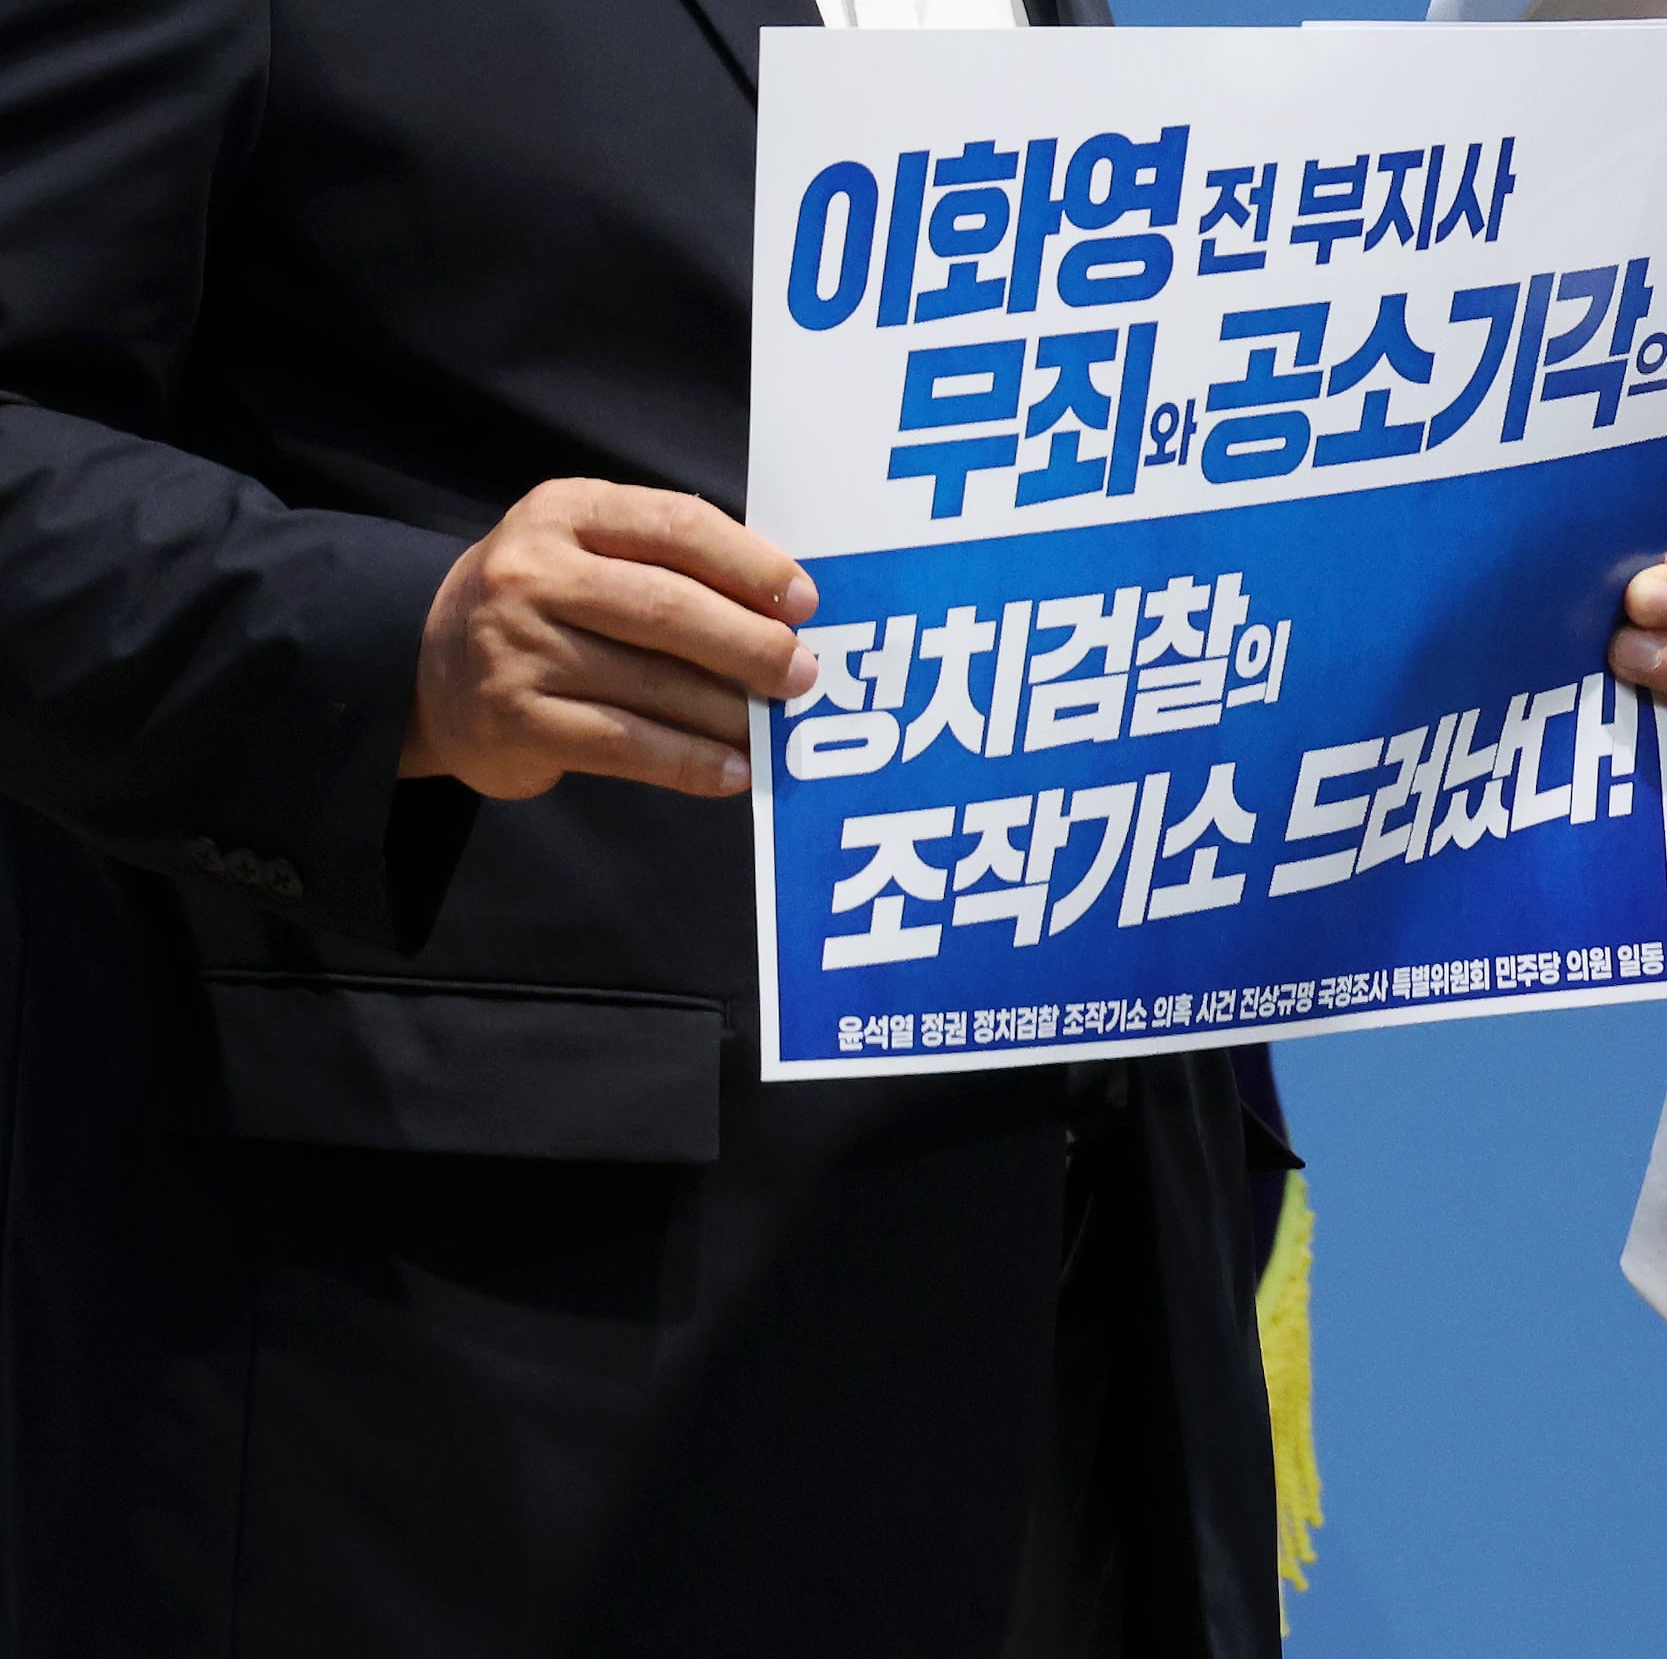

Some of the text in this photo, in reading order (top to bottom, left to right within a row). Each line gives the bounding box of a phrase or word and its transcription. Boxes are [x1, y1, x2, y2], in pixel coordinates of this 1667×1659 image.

[786, 124, 1516, 331] 이화영 전 부지사
[886, 321, 1198, 521] 무죄와
[784, 571, 1291, 781] 정치검찰의
[820, 672, 1638, 970] 조작기소 드러났다!
[838, 942, 1664, 1051] 윤석열 정권 정치검찰 조작기소 의혹 사건 진상규명 국정조사 특별위원회 민주당 의원 일동
